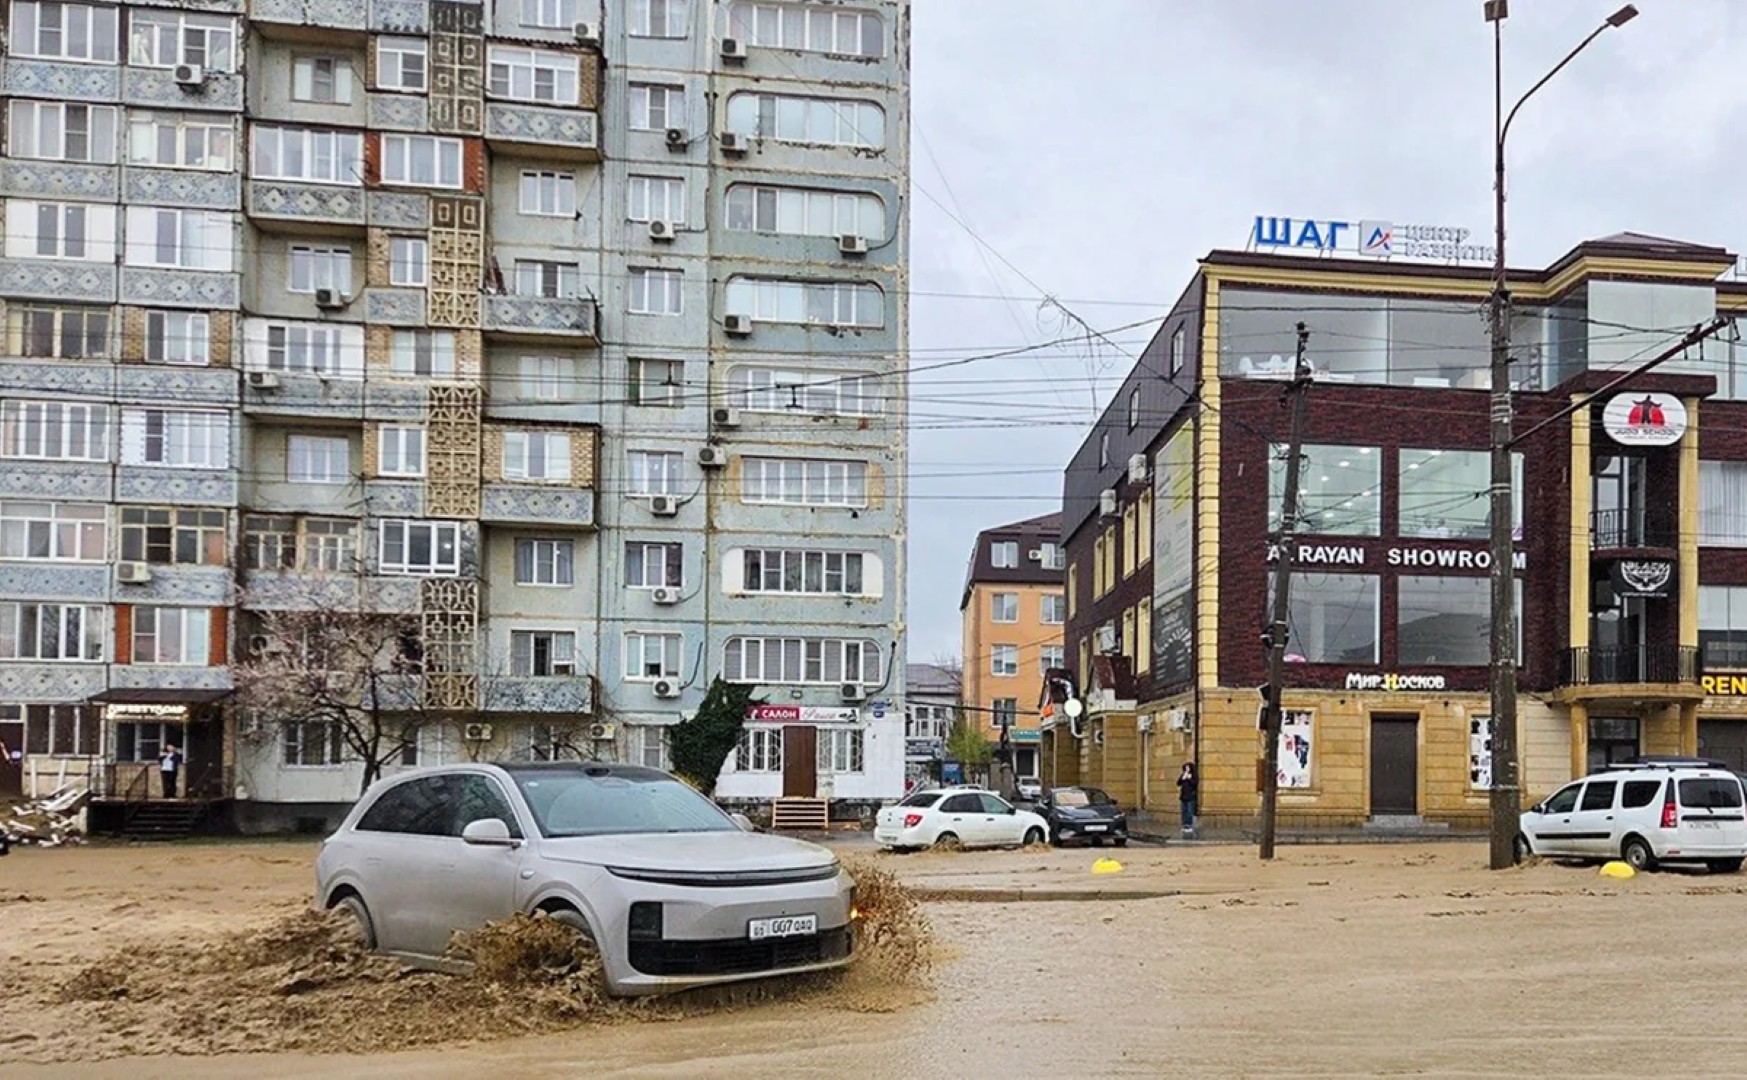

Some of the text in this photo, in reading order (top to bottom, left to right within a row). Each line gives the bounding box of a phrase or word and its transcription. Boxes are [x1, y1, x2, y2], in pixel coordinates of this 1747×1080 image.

[1255, 216, 1348, 248] ШАГ
[1405, 224, 1470, 243] ЦЕНТР
[1405, 242, 1498, 261] РАЗВИТИ
[1266, 545, 1526, 569] A RAYAN SHOWROM
[762, 709, 797, 718] САЛОН
